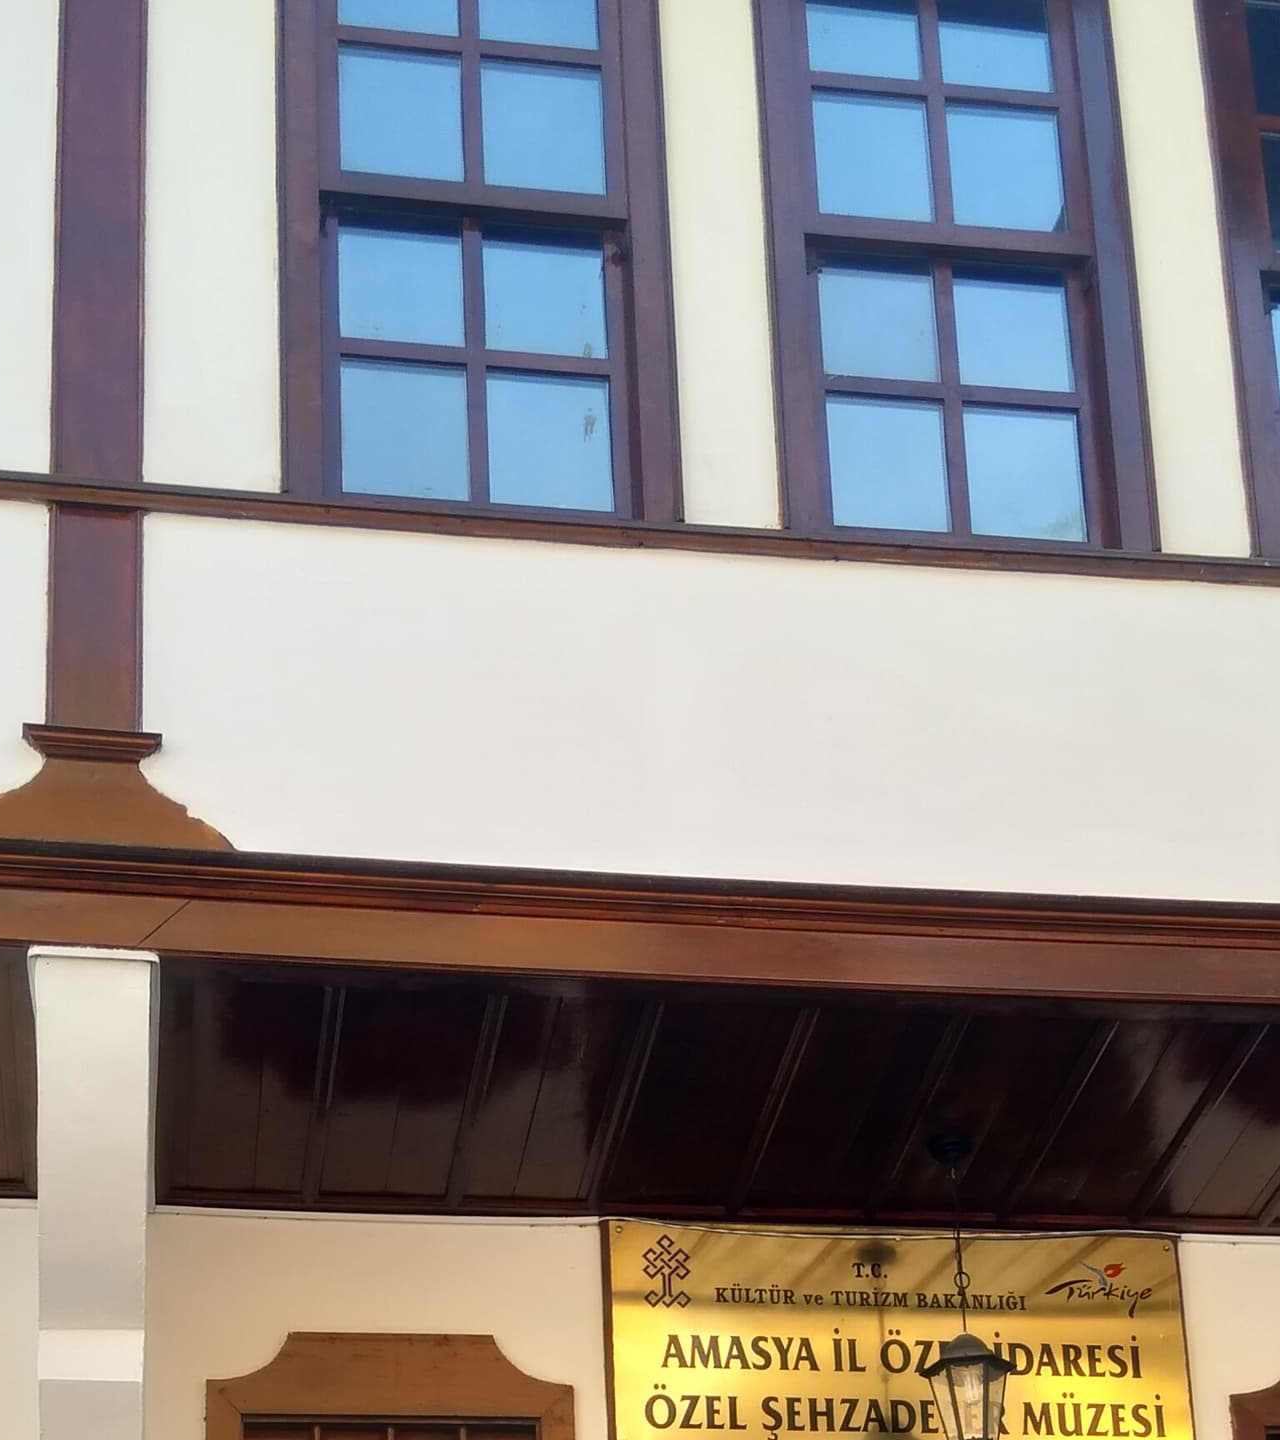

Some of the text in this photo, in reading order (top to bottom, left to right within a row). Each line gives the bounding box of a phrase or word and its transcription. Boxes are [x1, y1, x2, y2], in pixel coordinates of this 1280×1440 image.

[852, 1262, 889, 1279] T.C.
[713, 1283, 1028, 1311] KÜLTÜR ve TURİZM BAKANLIĞI
[1044, 1279, 1153, 1319] Türkiye
[660, 1327, 1143, 1379] AMASYA İL ÖZ İDARESİ
[644, 1382, 749, 1430] ÖZEL
[1022, 1391, 1168, 1438] MÜZESİ
